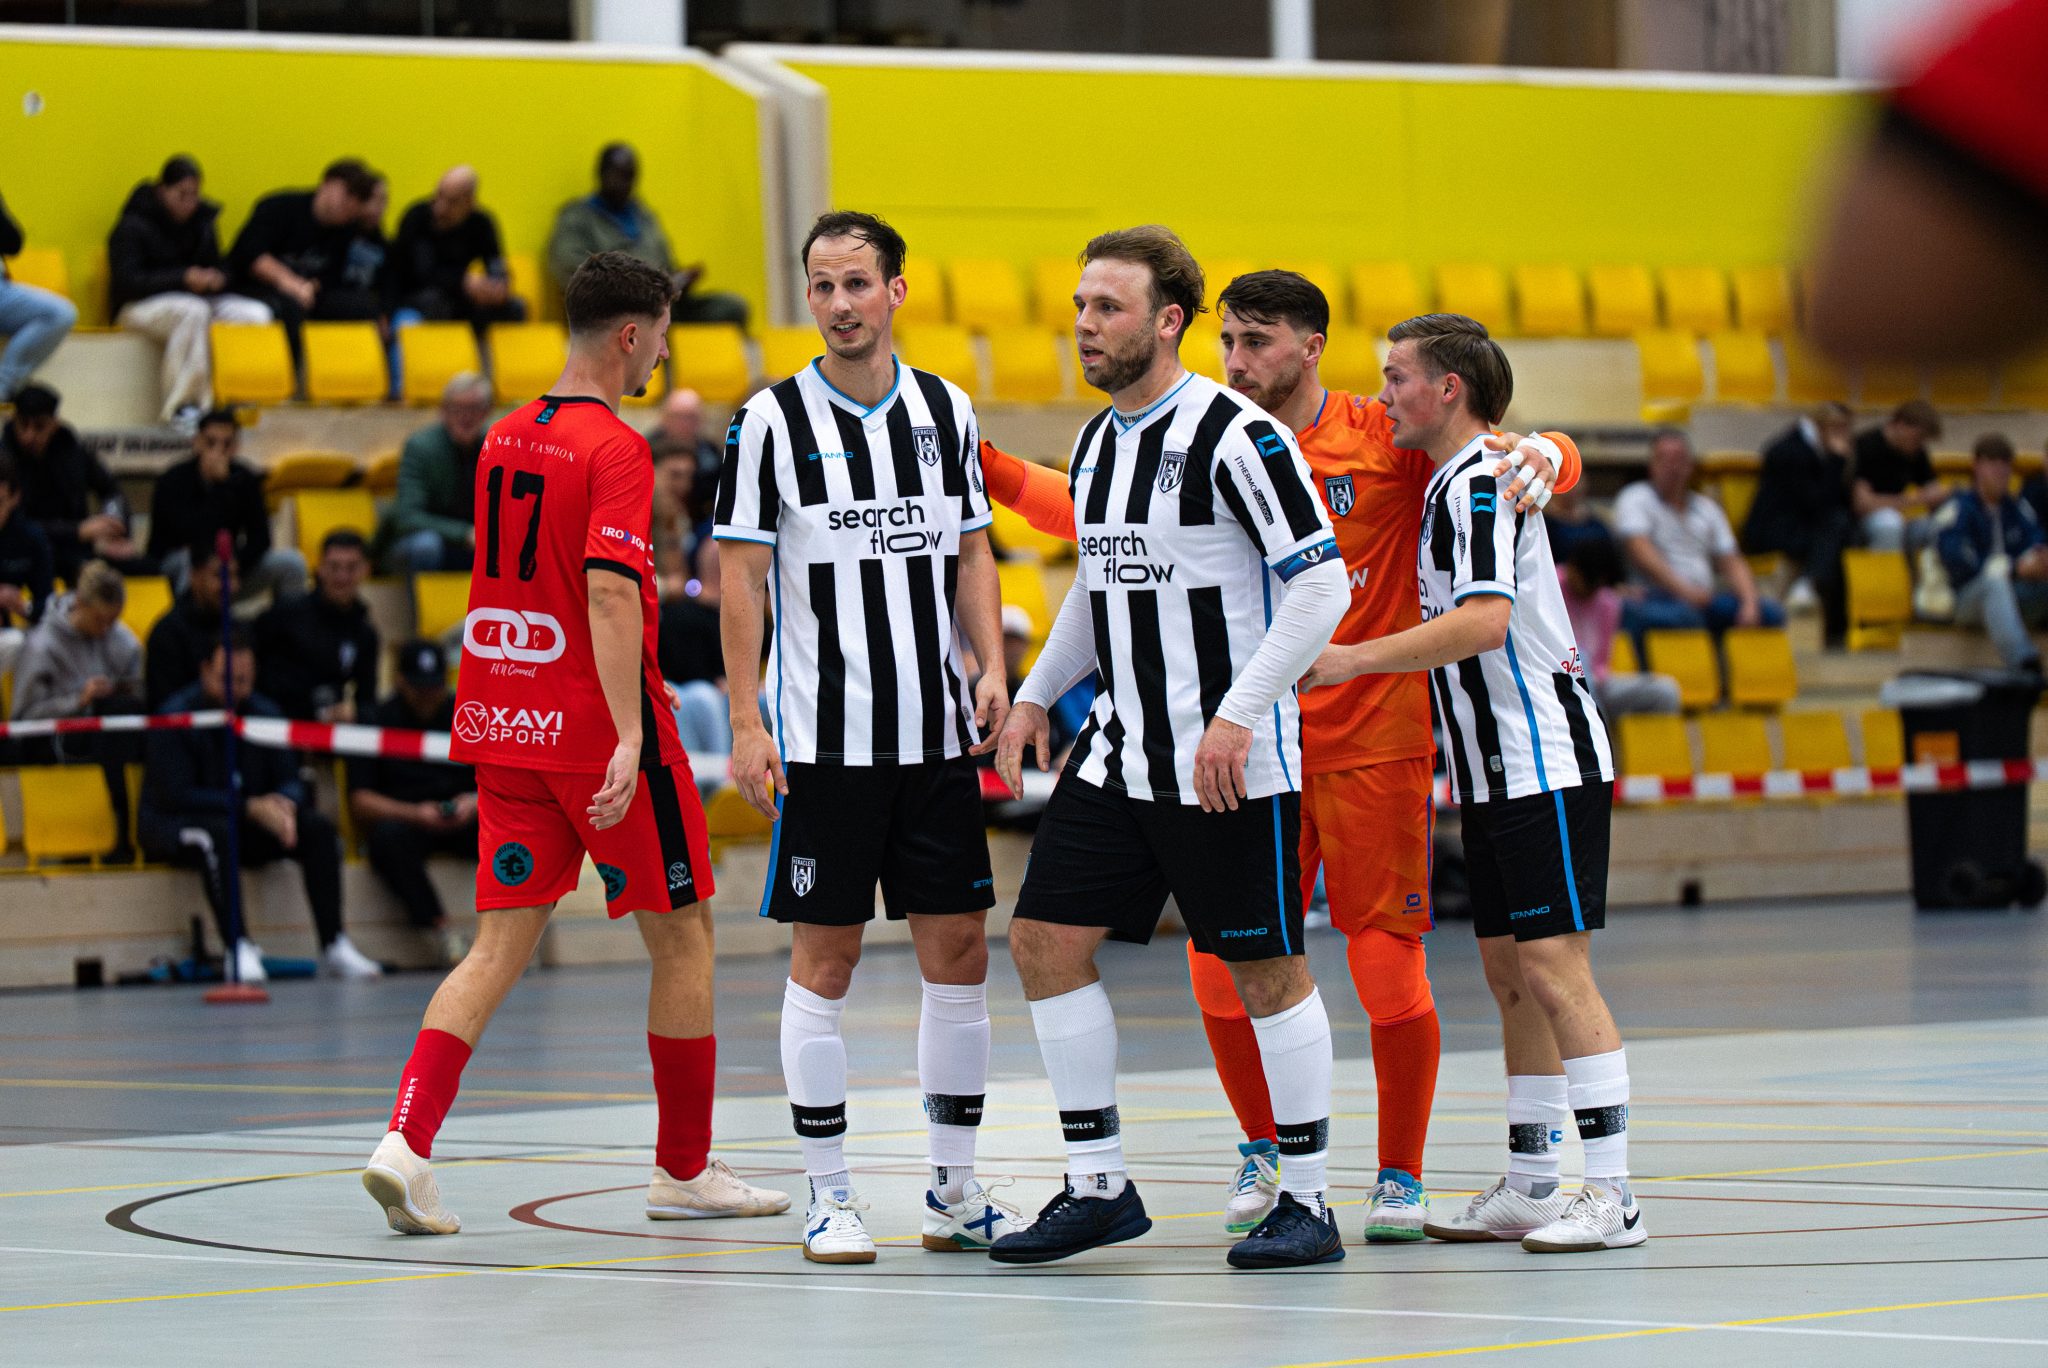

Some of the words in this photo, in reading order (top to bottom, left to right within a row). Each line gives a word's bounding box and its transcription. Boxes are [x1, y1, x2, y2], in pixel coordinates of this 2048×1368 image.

[530, 441, 576, 462] FASHION
[486, 465, 545, 582] 17
[828, 499, 925, 530] search
[870, 530, 943, 554] flow
[1081, 530, 1148, 556] search
[1103, 558, 1174, 584] flow
[490, 706, 563, 730] XAVI
[489, 727, 561, 746] SPORT
[668, 877, 693, 891] XAVI
[1510, 905, 1550, 920] STANNO
[1220, 927, 1268, 938] STANNO
[801, 1116, 842, 1126] HERACLES
[1062, 1121, 1096, 1130] RACLES
[1279, 1135, 1310, 1144] RACLES
